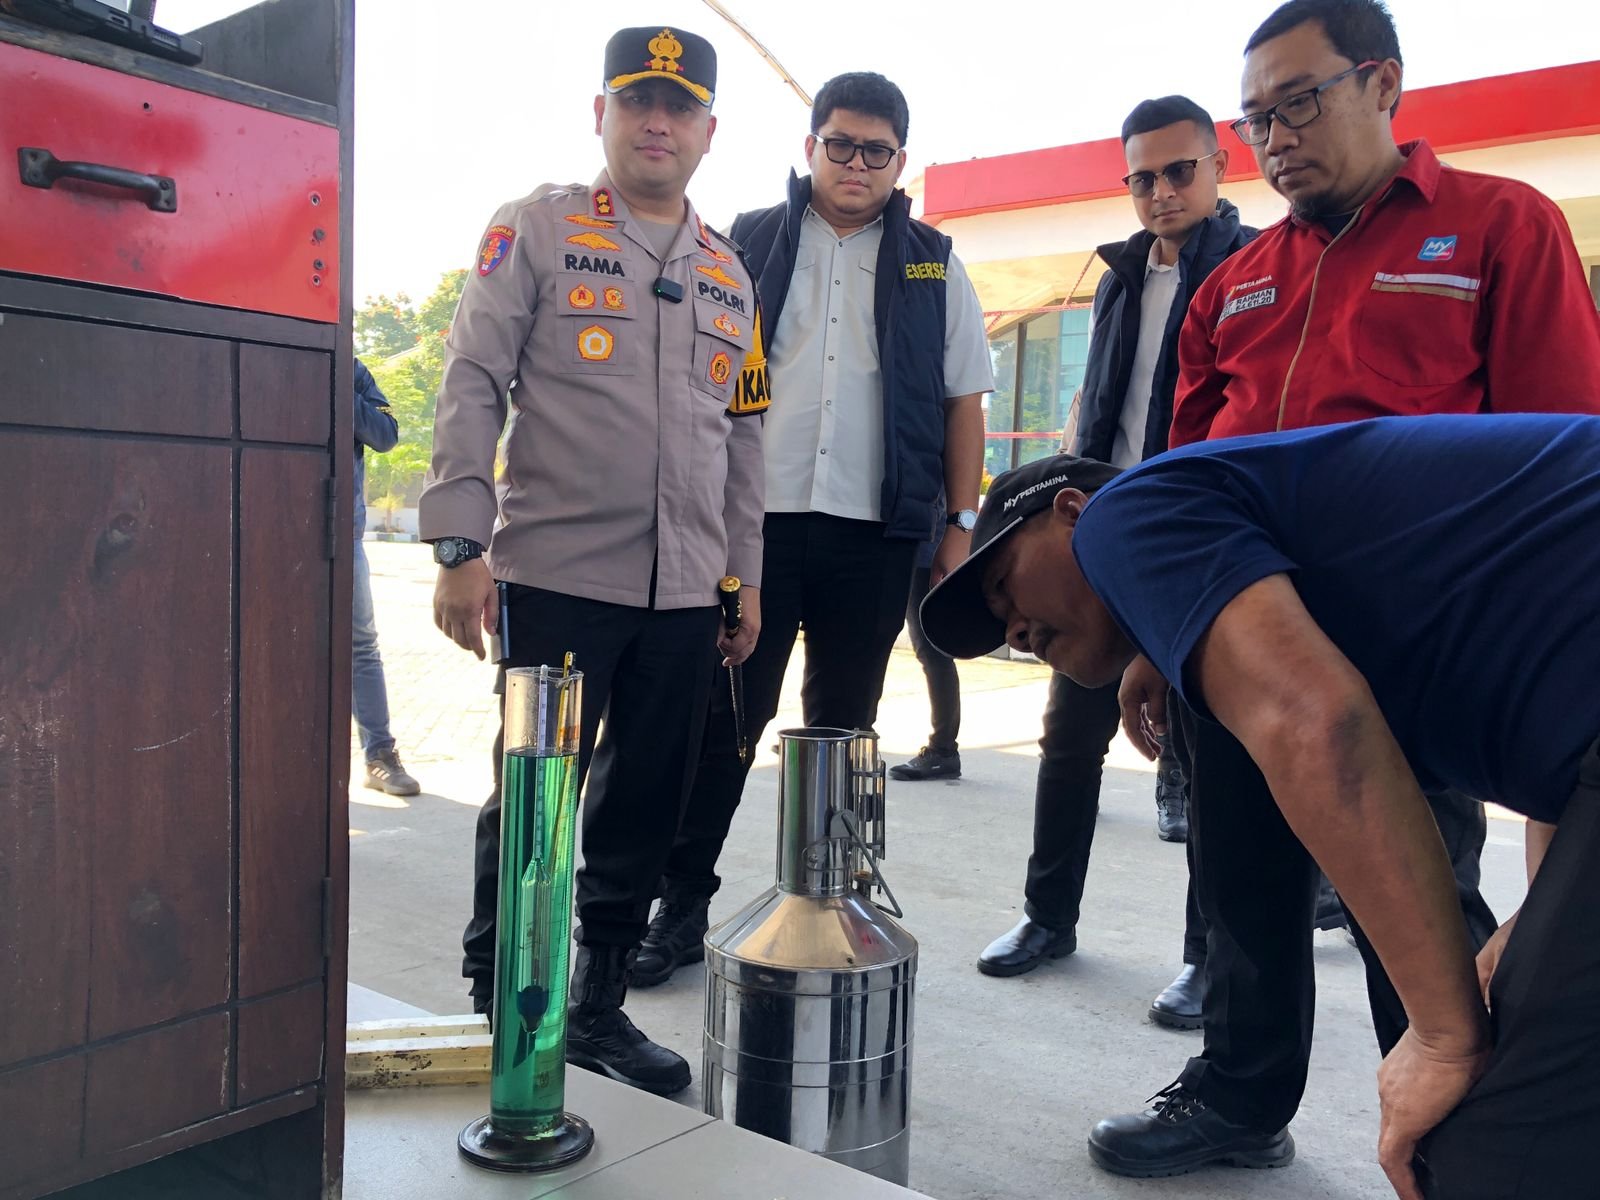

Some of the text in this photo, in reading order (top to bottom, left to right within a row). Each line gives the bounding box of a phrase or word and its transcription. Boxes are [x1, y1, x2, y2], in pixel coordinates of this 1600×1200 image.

[565, 254, 625, 277] RAMA
[698, 281, 745, 314] POLRI
[1236, 289, 1273, 306] RAHMAN
